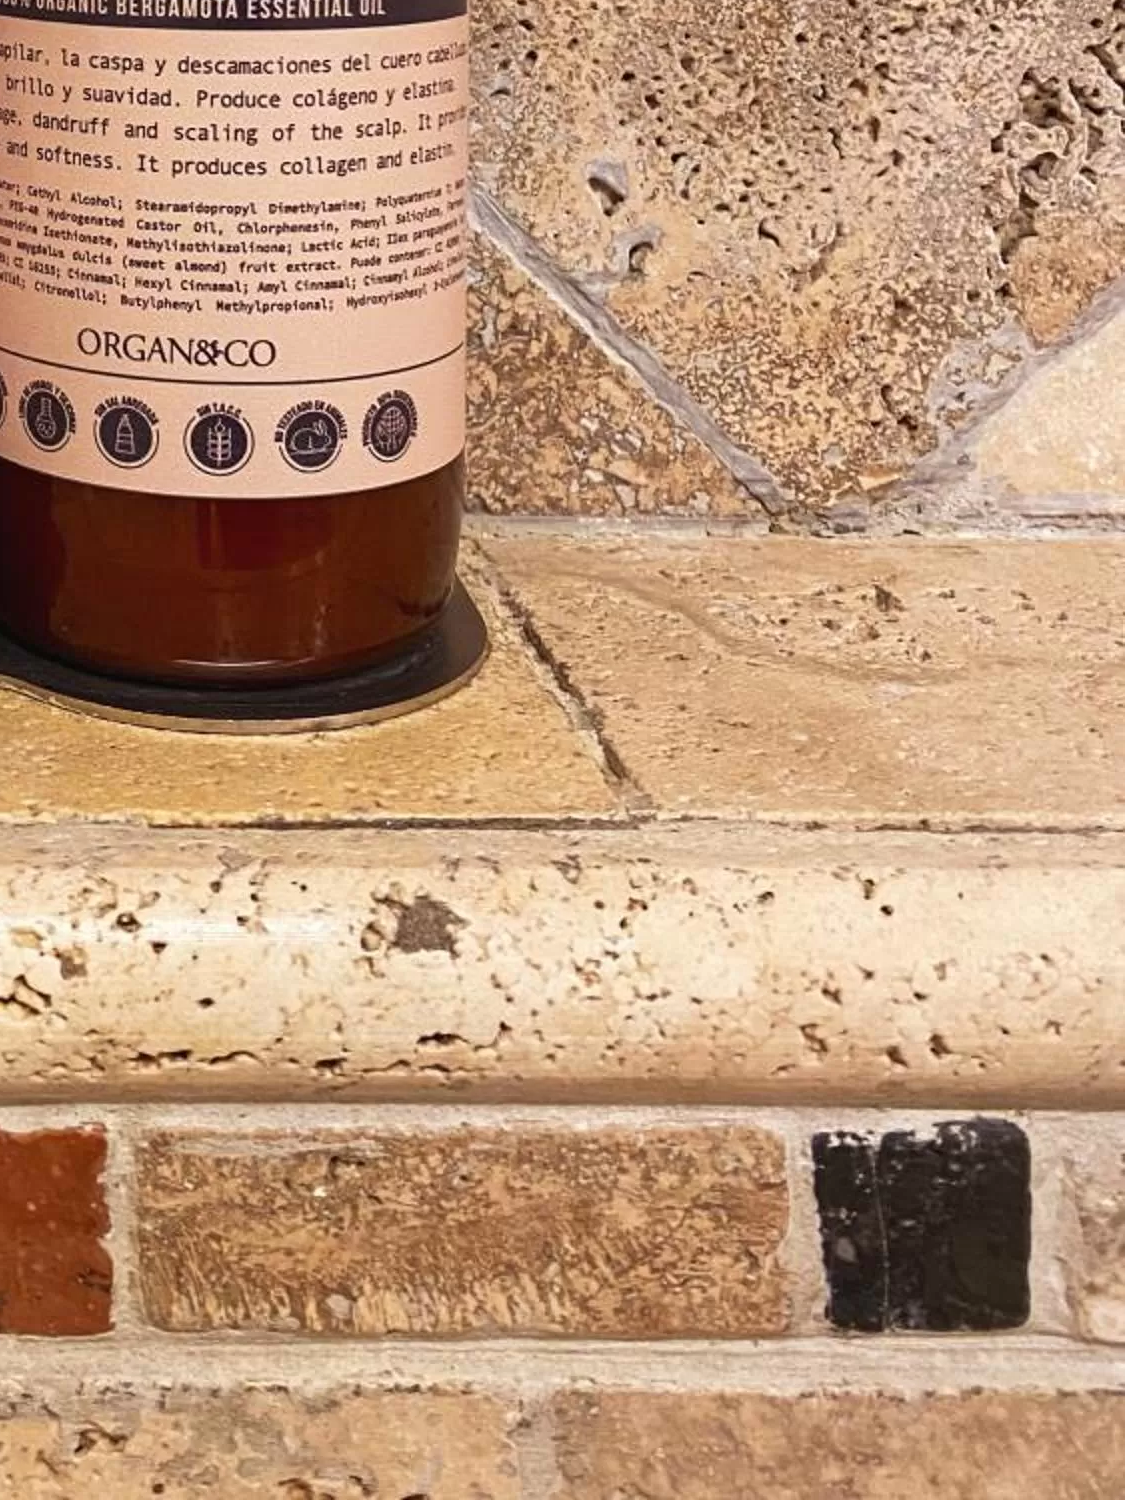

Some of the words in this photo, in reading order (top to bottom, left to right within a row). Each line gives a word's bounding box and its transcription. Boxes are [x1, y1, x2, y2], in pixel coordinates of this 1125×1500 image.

[61, 49, 79, 67] la
[89, 53, 144, 74] caspa
[155, 59, 166, 76] y
[178, 57, 332, 75] descamaciones
[342, 54, 370, 71] del
[380, 51, 422, 69] cuero
[6, 75, 54, 97] brillo
[63, 85, 72, 102] y
[83, 86, 181, 107] suavidad.
[196, 89, 281, 108] Produce
[292, 88, 378, 110] colágeno
[387, 88, 395, 105] y
[33, 112, 110, 135] dandruff
[125, 122, 158, 139] and
[174, 123, 258, 146] scaling
[272, 123, 296, 141] of
[311, 123, 343, 140] the
[356, 118, 407, 139] scalp.
[418, 113, 432, 131] It
[6, 139, 28, 156] and
[36, 145, 121, 170] softness.
[138, 154, 159, 172] It
[172, 158, 267, 179] produces
[281, 156, 367, 177] collagen
[376, 151, 402, 169] and
[136, 219, 182, 231] Castor
[193, 221, 223, 235] Oil,
[239, 261, 277, 273] fruit
[286, 260, 342, 273] extract.
[257, 281, 287, 293] Amyl
[77, 327, 276, 367] ORGAN&CO
